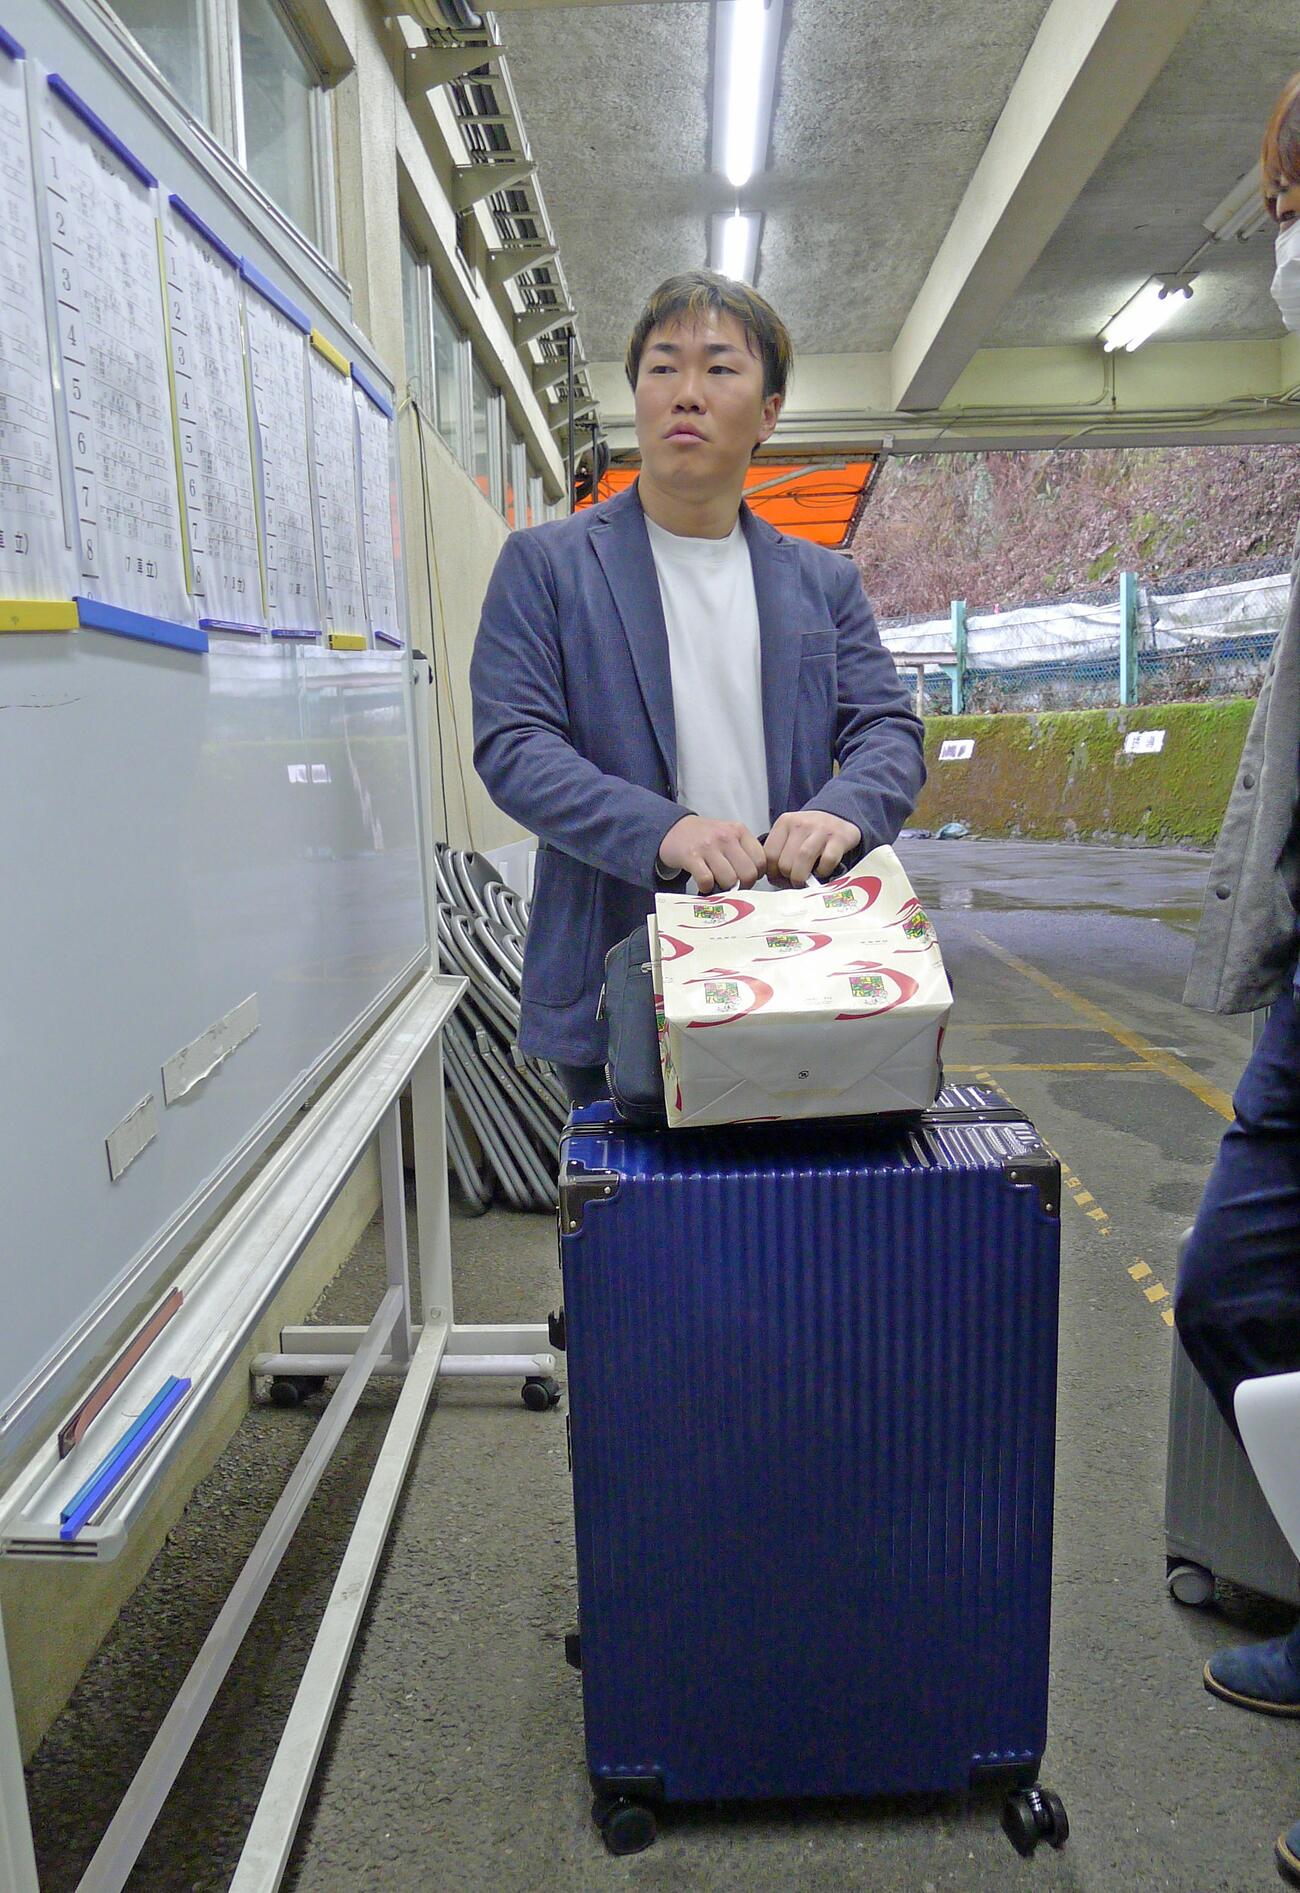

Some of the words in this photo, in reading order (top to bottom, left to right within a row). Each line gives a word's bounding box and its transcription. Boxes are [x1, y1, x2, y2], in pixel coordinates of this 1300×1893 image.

[51, 156, 59, 179] 1
[56, 212, 66, 236] 2
[171, 257, 176, 275] 1
[62, 268, 72, 291] 3
[174, 302, 181, 320] 2
[68, 324, 77, 346] 4
[178, 346, 185, 365] 3
[73, 378, 82, 400] 5
[182, 392, 189, 409] 4
[77, 432, 86, 454] 6
[185, 434, 193, 453] 5
[82, 486, 89, 507] 7
[189, 479, 196, 497] 6
[192, 522, 198, 540] 7
[86, 540, 93, 561] 8
[196, 566, 201, 583] 8
